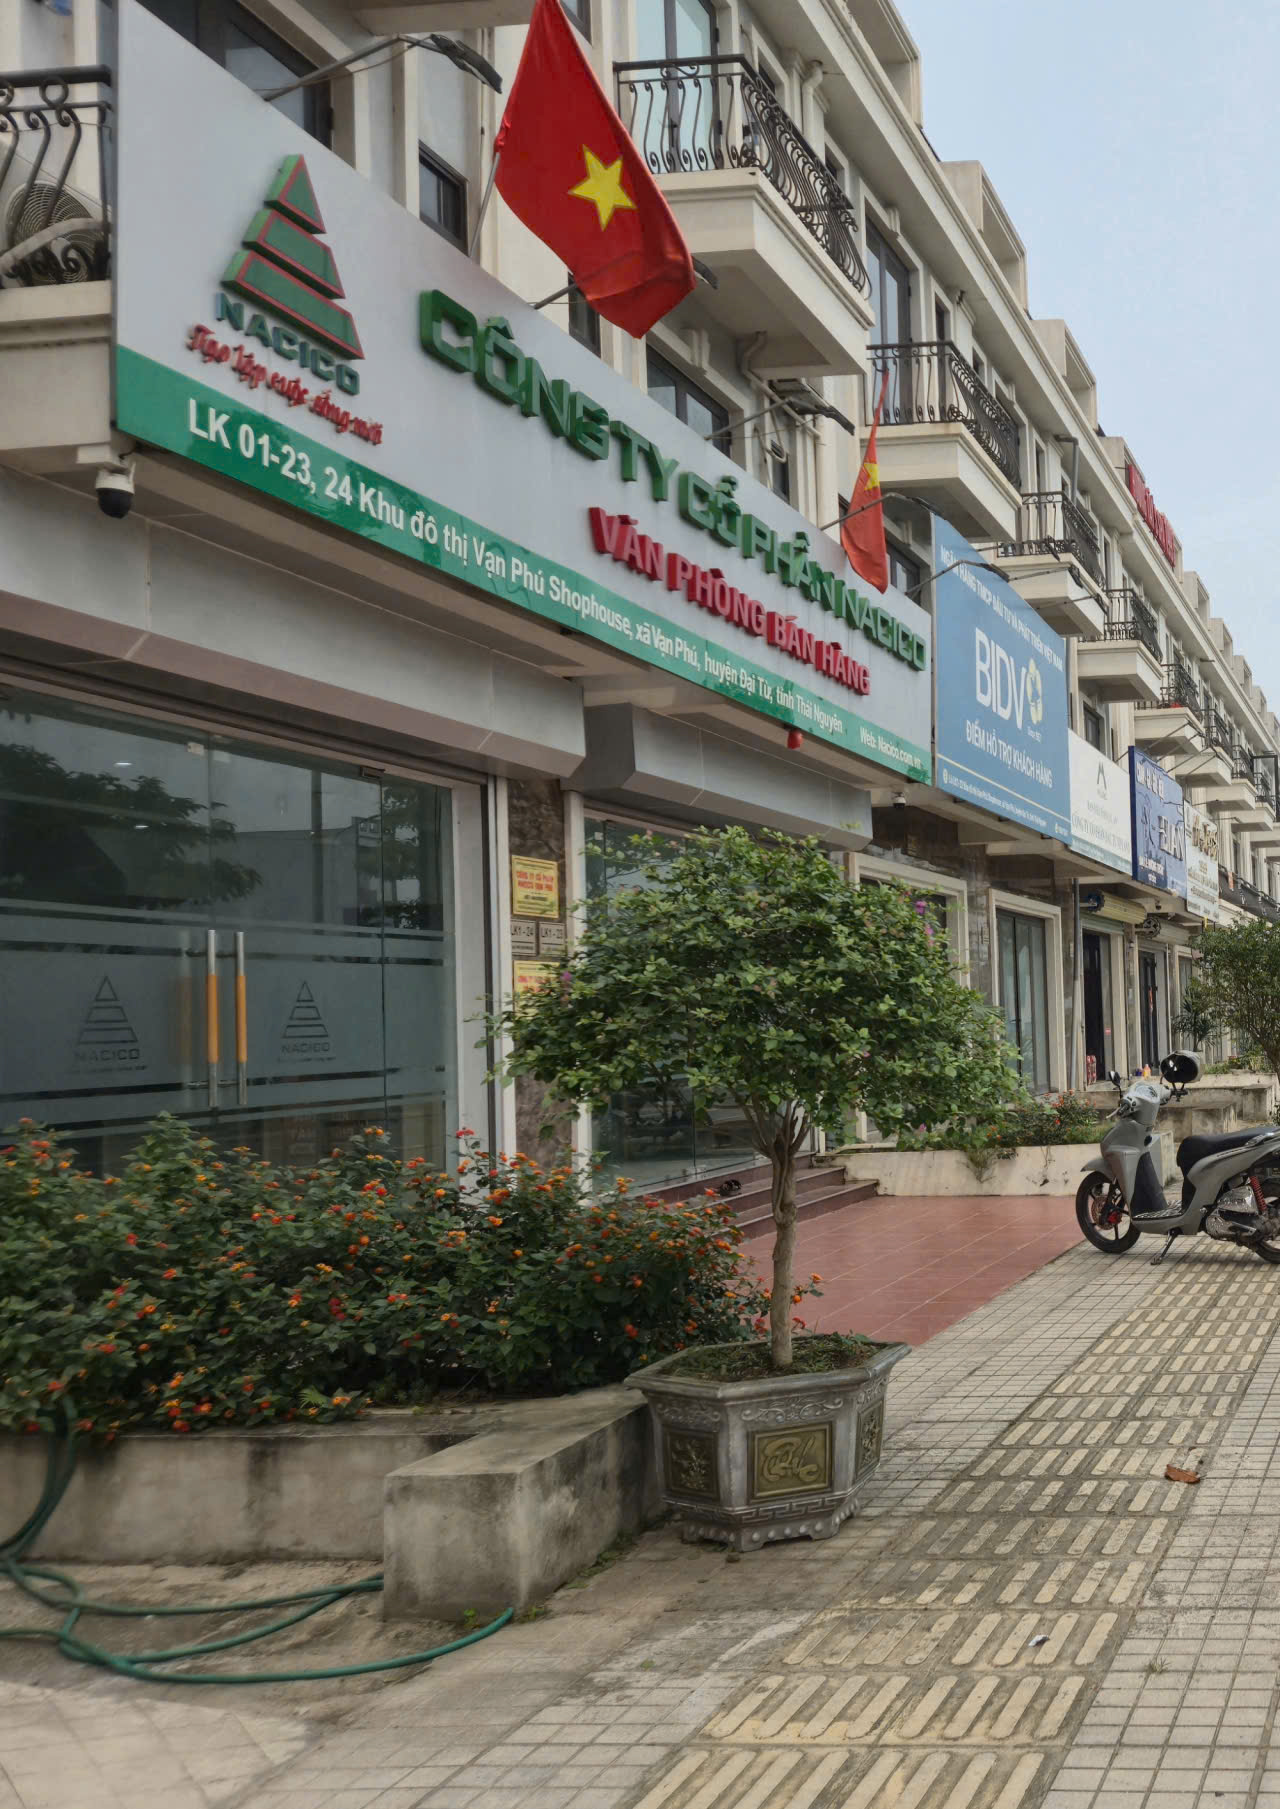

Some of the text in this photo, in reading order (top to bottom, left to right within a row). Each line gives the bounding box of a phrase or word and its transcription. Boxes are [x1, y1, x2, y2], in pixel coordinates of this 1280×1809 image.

[215, 292, 360, 396] NACICO
[419, 289, 927, 671] CÔNG TY CỔ PHẦN NACICO
[189, 397, 232, 450] LK
[239, 423, 318, 495] 01-23,
[324, 465, 353, 506] 24
[358, 482, 405, 531] Khu
[411, 510, 438, 545] đô
[443, 525, 469, 567] thị
[473, 537, 506, 578] Vạn
[511, 557, 545, 596] Phú
[549, 575, 634, 640] Shophouse,
[635, 621, 651, 646] xã
[652, 627, 675, 657] Vạn
[674, 636, 701, 671] Phú,
[704, 651, 738, 687] huyện
[739, 668, 756, 696] Đại
[757, 675, 773, 704] Từ,
[776, 685, 794, 711] tỉnh
[796, 694, 812, 720] Thái
[813, 705, 843, 733] Nguyên
[859, 727, 877, 749] Web:
[588, 507, 871, 696] VĂN PHÒNG BÁN HÀNG
[975, 626, 1027, 730] BIDV
[965, 718, 986, 751] ĐIỂM
[998, 738, 1013, 769] TRỢ
[1012, 747, 1036, 783] KHÁCH
[1035, 759, 1053, 789] HÀNG
